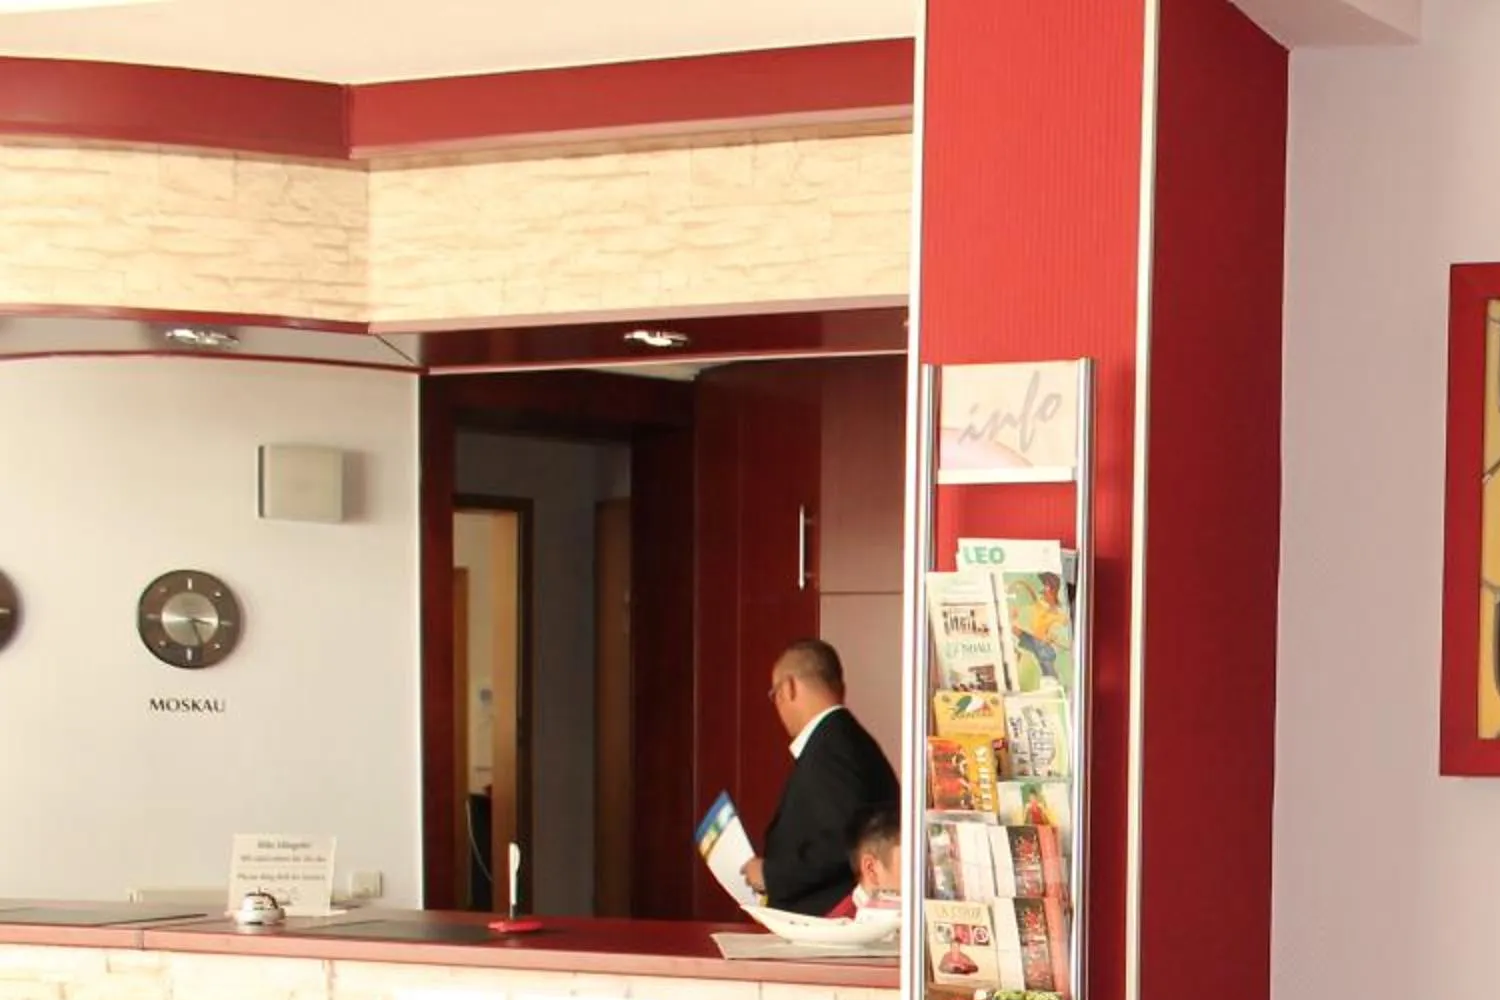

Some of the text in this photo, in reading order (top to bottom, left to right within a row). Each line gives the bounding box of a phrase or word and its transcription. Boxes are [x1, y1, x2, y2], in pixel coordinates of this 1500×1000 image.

[959, 370, 1063, 454] info
[963, 545, 1006, 565] LEO
[149, 697, 226, 713] MOSKAU
